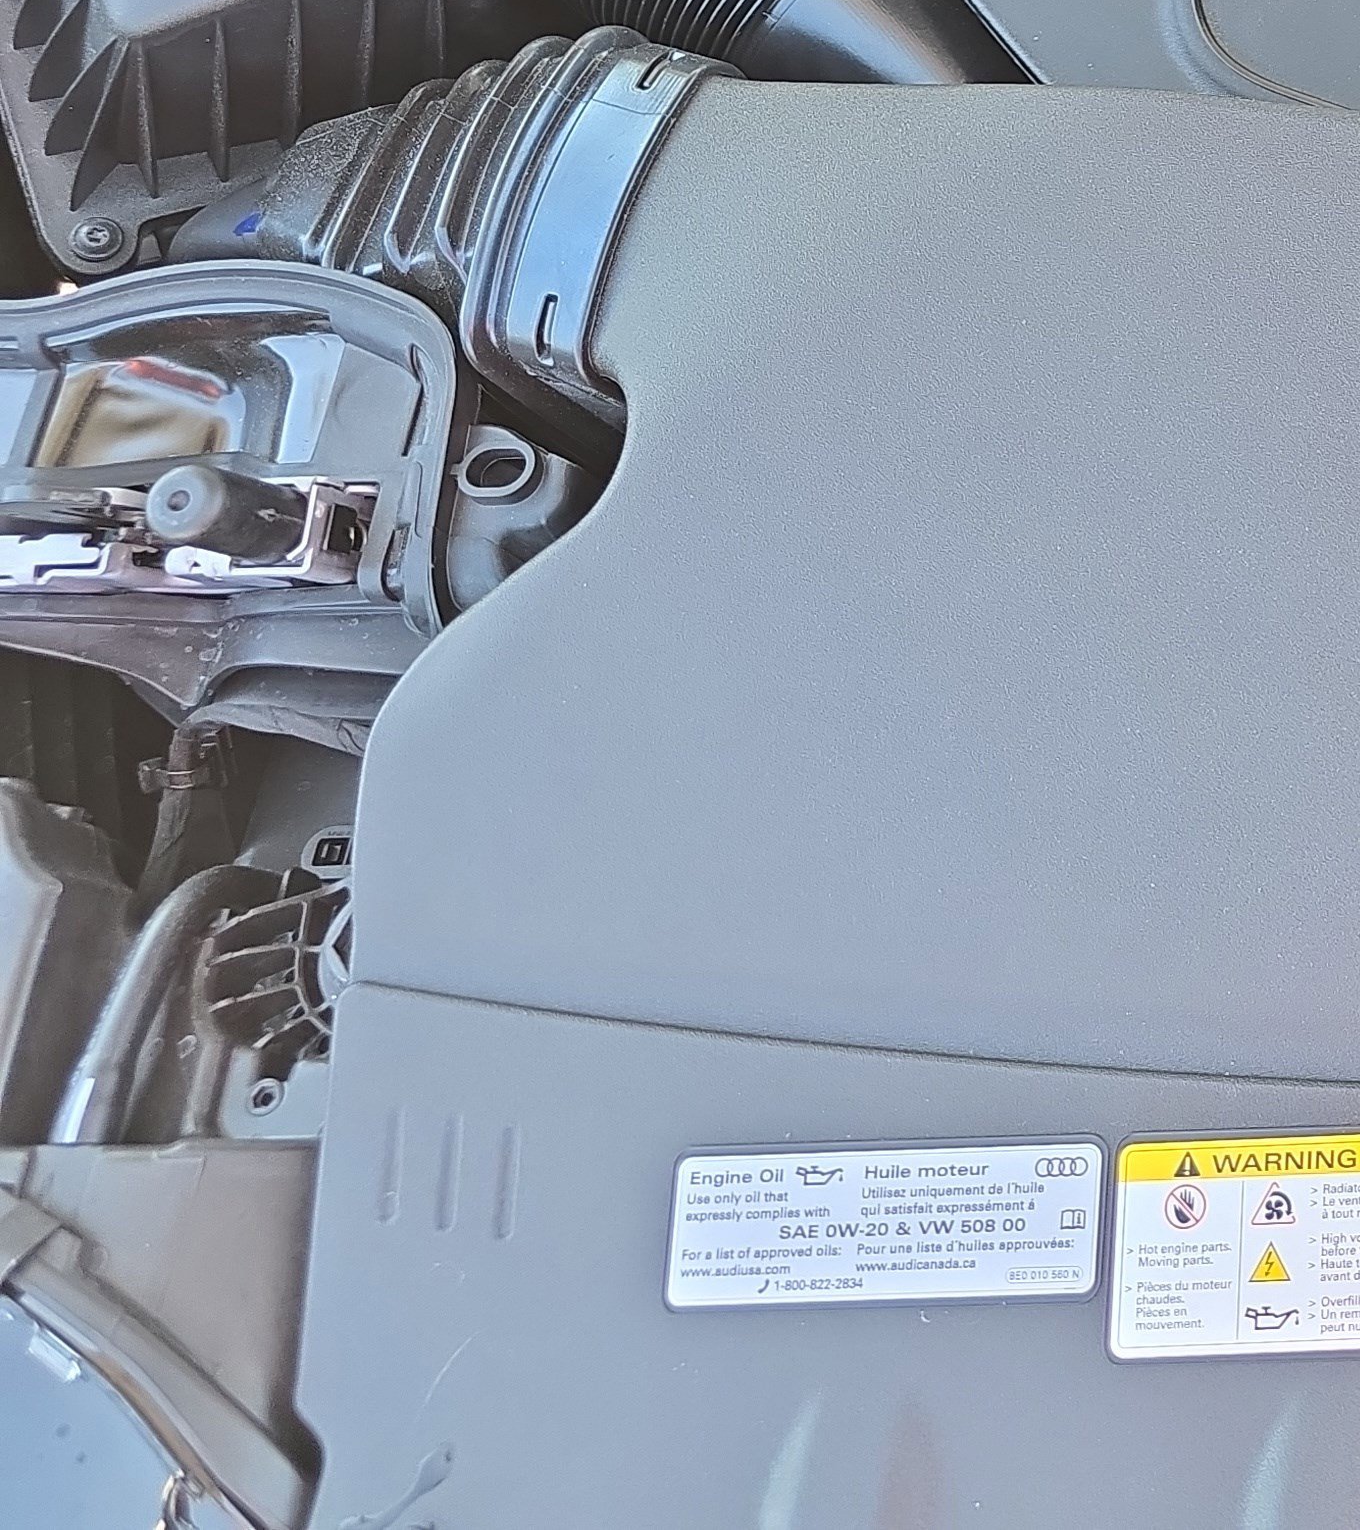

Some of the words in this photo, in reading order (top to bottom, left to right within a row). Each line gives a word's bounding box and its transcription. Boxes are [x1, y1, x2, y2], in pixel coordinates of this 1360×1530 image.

[1212, 1148, 1357, 1174] WARNING
[689, 1170, 753, 1187] Engine
[759, 1168, 784, 1183] Oil
[864, 1164, 912, 1180] Huile
[917, 1164, 990, 1178] moteur
[687, 1193, 711, 1205] Use
[714, 1192, 742, 1206] only
[744, 1191, 761, 1204] oil
[763, 1190, 789, 1203] that
[861, 1186, 907, 1200] Utilisez
[909, 1185, 985, 1199] uniquement
[987, 1183, 1004, 1195] de
[1322, 1196, 1336, 1207] Le
[685, 1208, 743, 1224] expressly
[745, 1206, 801, 1222] complies
[803, 1205, 831, 1218] with
[860, 1203, 881, 1218] qui
[884, 1202, 934, 1216] satisfait
[936, 1200, 1025, 1216] expressément
[1331, 1209, 1354, 1220] tout
[778, 1224, 819, 1240] SAE
[825, 1222, 889, 1238] 0W-20
[895, 1221, 911, 1236] &
[918, 1219, 955, 1235] VW
[960, 1218, 996, 1234] 508
[1002, 1217, 1026, 1232] 00
[856, 1243, 887, 1256] Pour
[889, 1244, 913, 1255] une
[916, 1241, 943, 1254] liste
[998, 1236, 1075, 1253] approuvées:
[1321, 1232, 1347, 1246] High
[681, 1248, 702, 1261] For
[704, 1251, 713, 1261] a
[715, 1247, 735, 1260] list
[737, 1246, 752, 1260] of
[753, 1244, 813, 1261] approved
[815, 1243, 842, 1257] oils:
[1138, 1244, 1159, 1255] Hot
[1160, 1242, 1199, 1256] engine
[1201, 1242, 1233, 1255] parts.
[1320, 1245, 1357, 1257] before
[855, 1258, 976, 1272] www.audicanada.ca
[1138, 1255, 1180, 1268] Moving
[1182, 1255, 1214, 1268] parts.
[1320, 1258, 1353, 1270] Haute
[680, 1264, 791, 1278] www.audiusa.com
[1030, 1269, 1049, 1280] 010
[1072, 1269, 1080, 1279] N
[1319, 1271, 1351, 1282] avant
[774, 1277, 864, 1291] 1-800-822-2834
[1136, 1281, 1172, 1293] Pièces
[1174, 1280, 1189, 1291] du
[1191, 1280, 1233, 1291] moteur
[1136, 1293, 1185, 1306] chaudes.
[1135, 1306, 1171, 1318] Pièces
[1173, 1308, 1188, 1317] en
[1320, 1309, 1337, 1320] Un
[1135, 1319, 1205, 1331] mouvement.
[1320, 1322, 1346, 1335] peut
